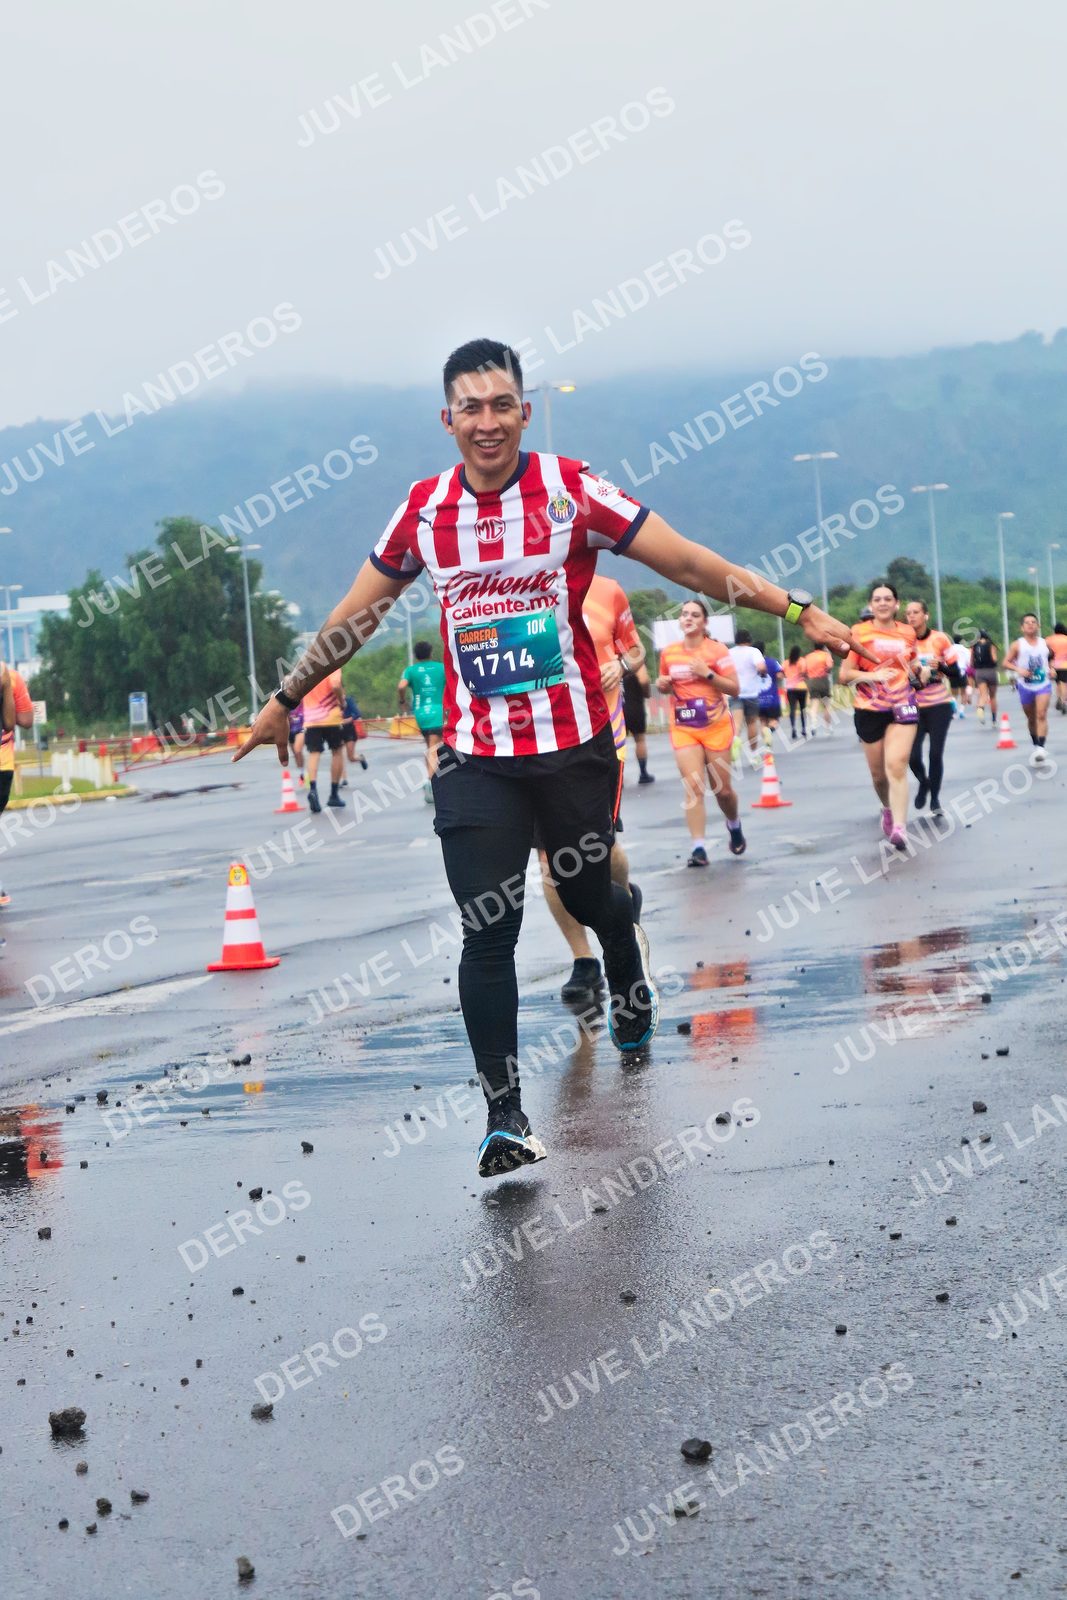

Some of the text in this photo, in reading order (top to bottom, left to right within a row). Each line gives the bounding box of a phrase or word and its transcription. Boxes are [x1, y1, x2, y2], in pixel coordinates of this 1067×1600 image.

[476, 518, 504, 541] MG
[443, 570, 558, 607] Caliente
[452, 594, 560, 620] caliente.mx
[459, 627, 498, 644] CARRERA
[526, 618, 546, 635] 10K
[473, 648, 535, 676] 1714
[681, 708, 696, 718] 687
